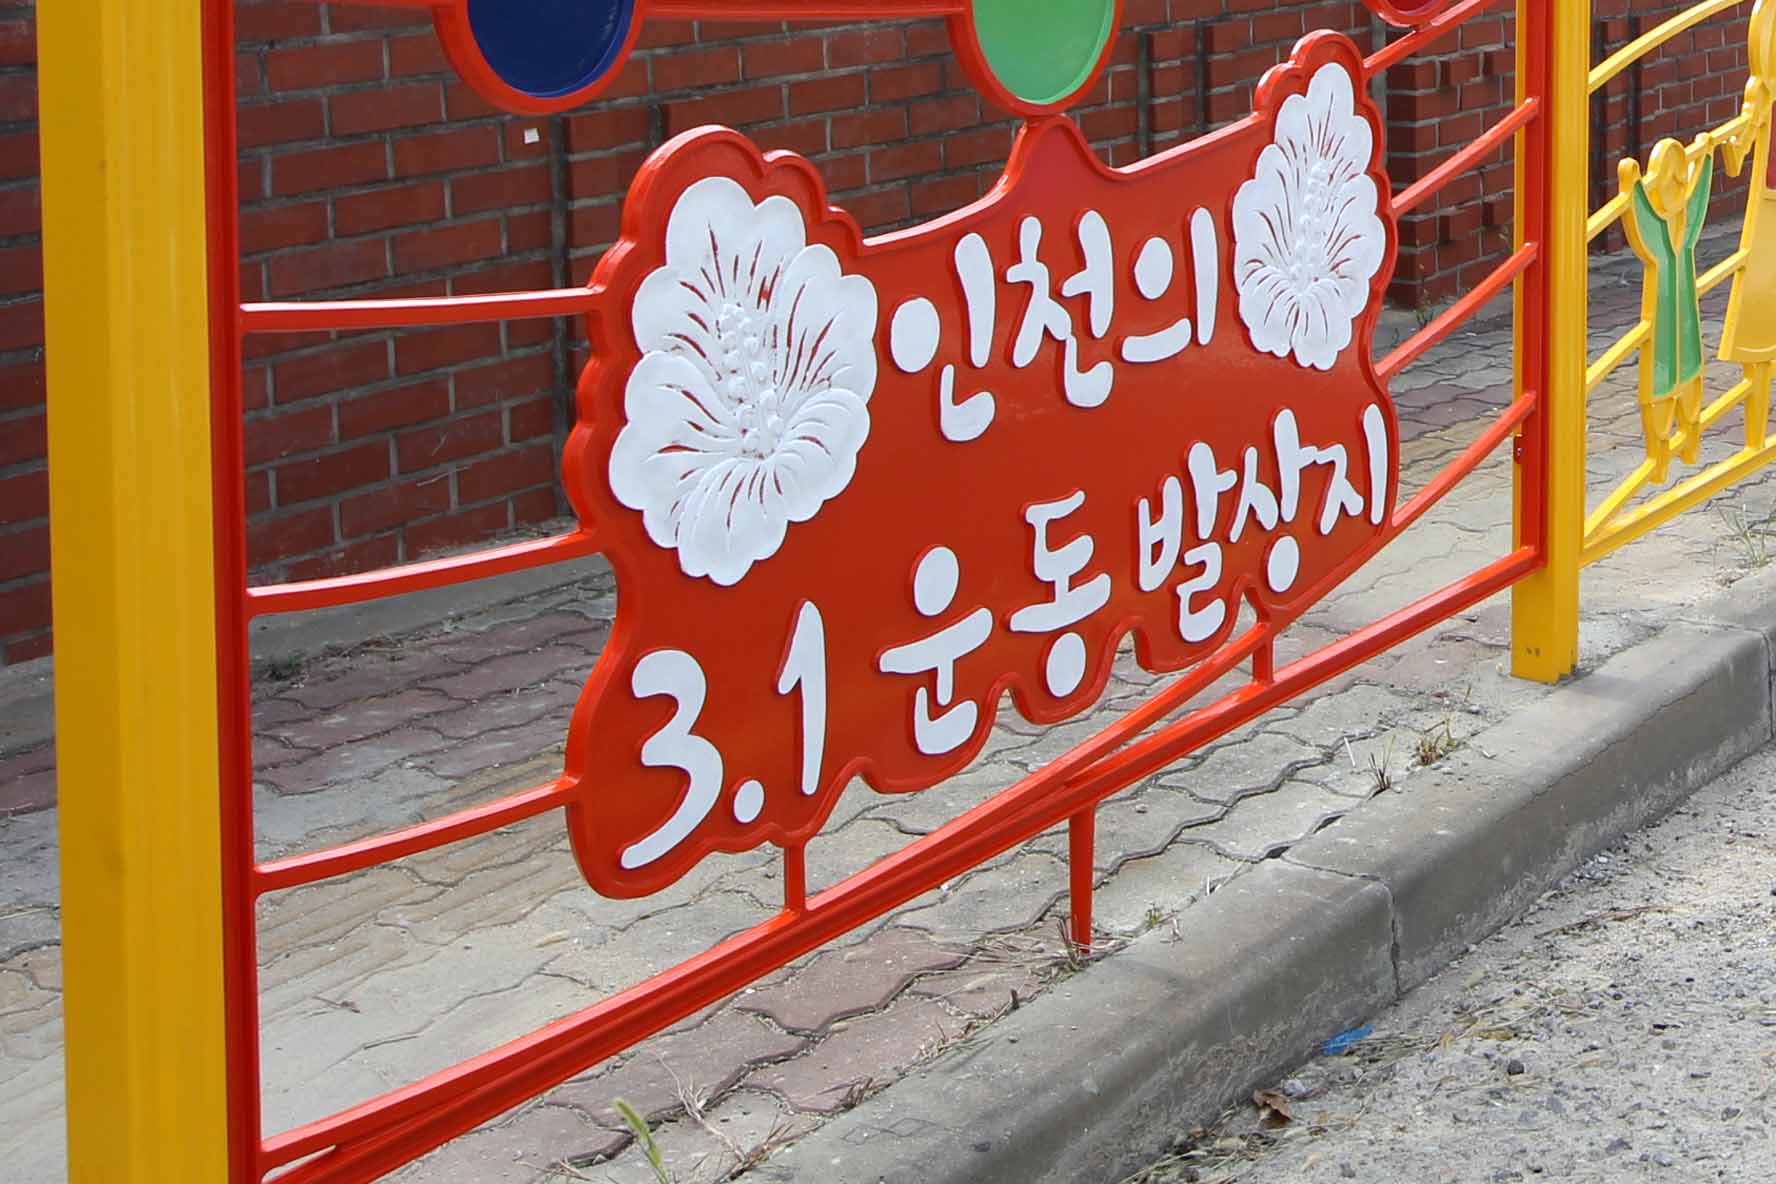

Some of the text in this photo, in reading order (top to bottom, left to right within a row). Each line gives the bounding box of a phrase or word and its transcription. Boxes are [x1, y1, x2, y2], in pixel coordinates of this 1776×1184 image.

[889, 206, 1217, 443] 인천의
[619, 402, 1389, 870] 3.1 운동 발상지
